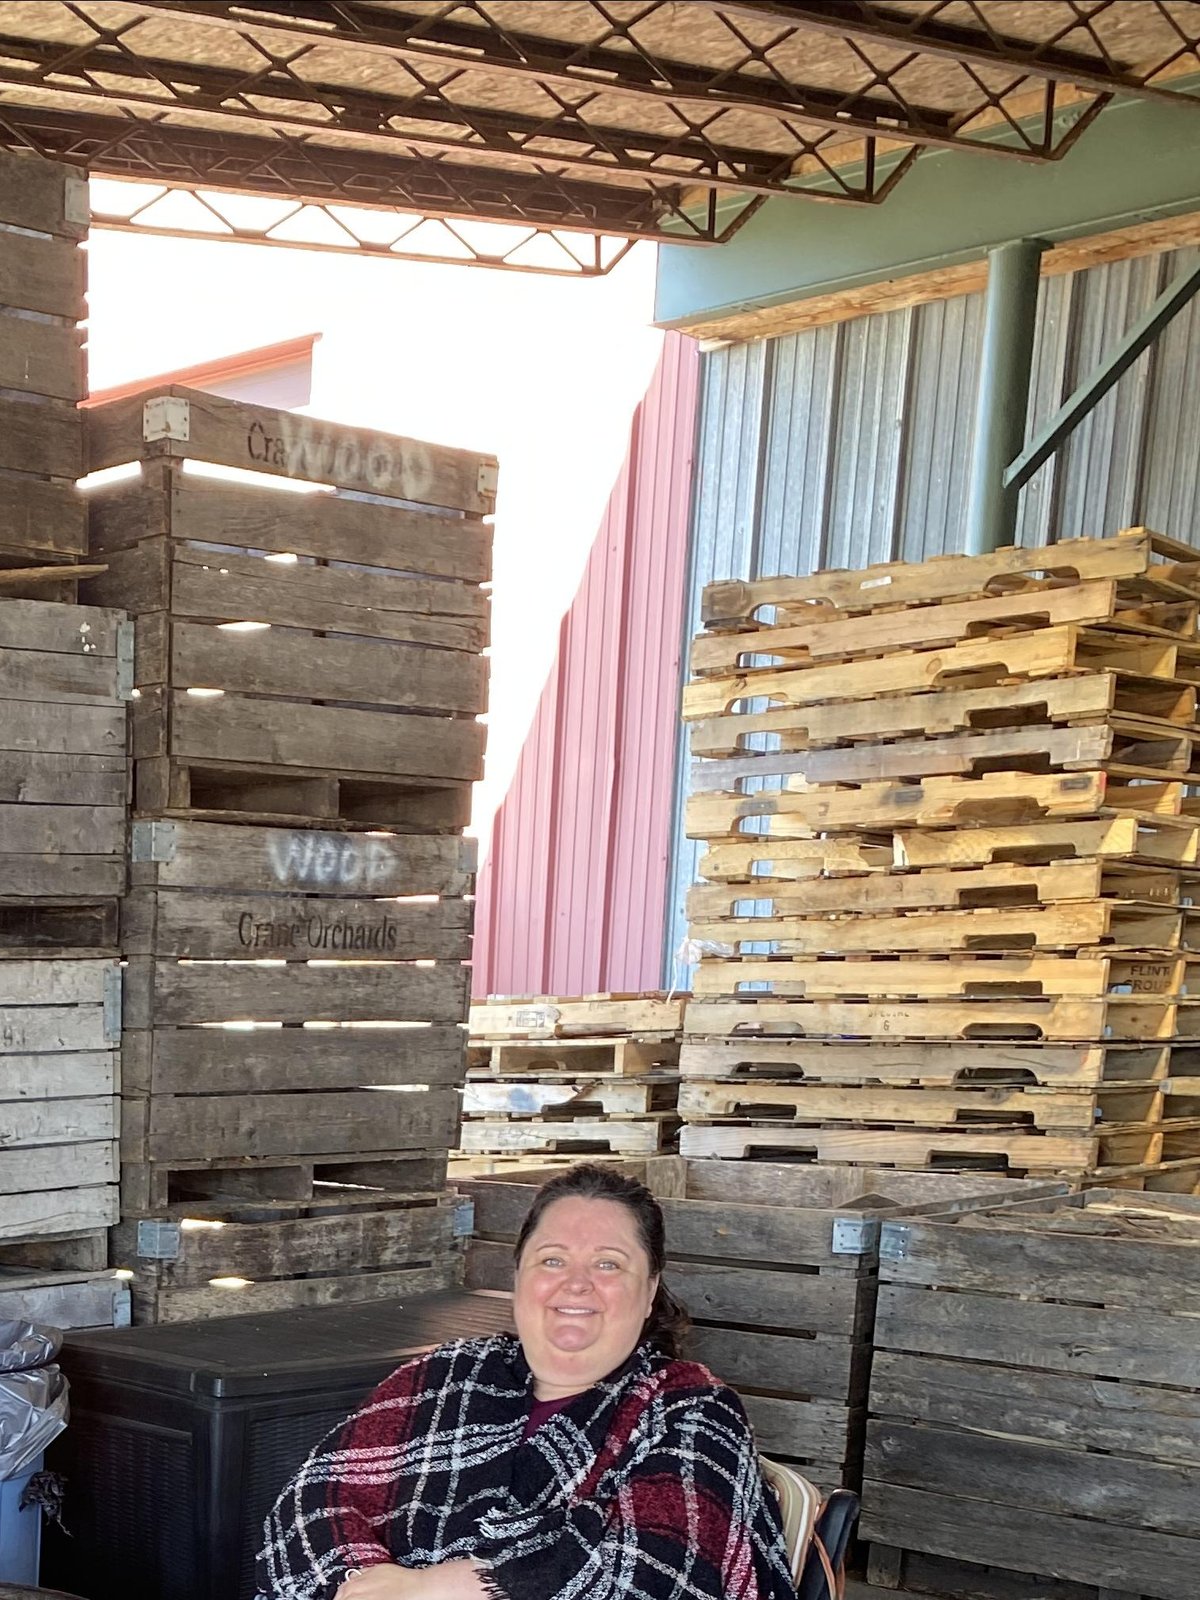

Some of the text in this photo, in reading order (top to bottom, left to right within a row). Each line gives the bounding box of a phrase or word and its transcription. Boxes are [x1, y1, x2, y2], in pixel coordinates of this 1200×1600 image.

[238, 911, 398, 951] Crane Orchards
[1130, 965, 1171, 977] FLINT
